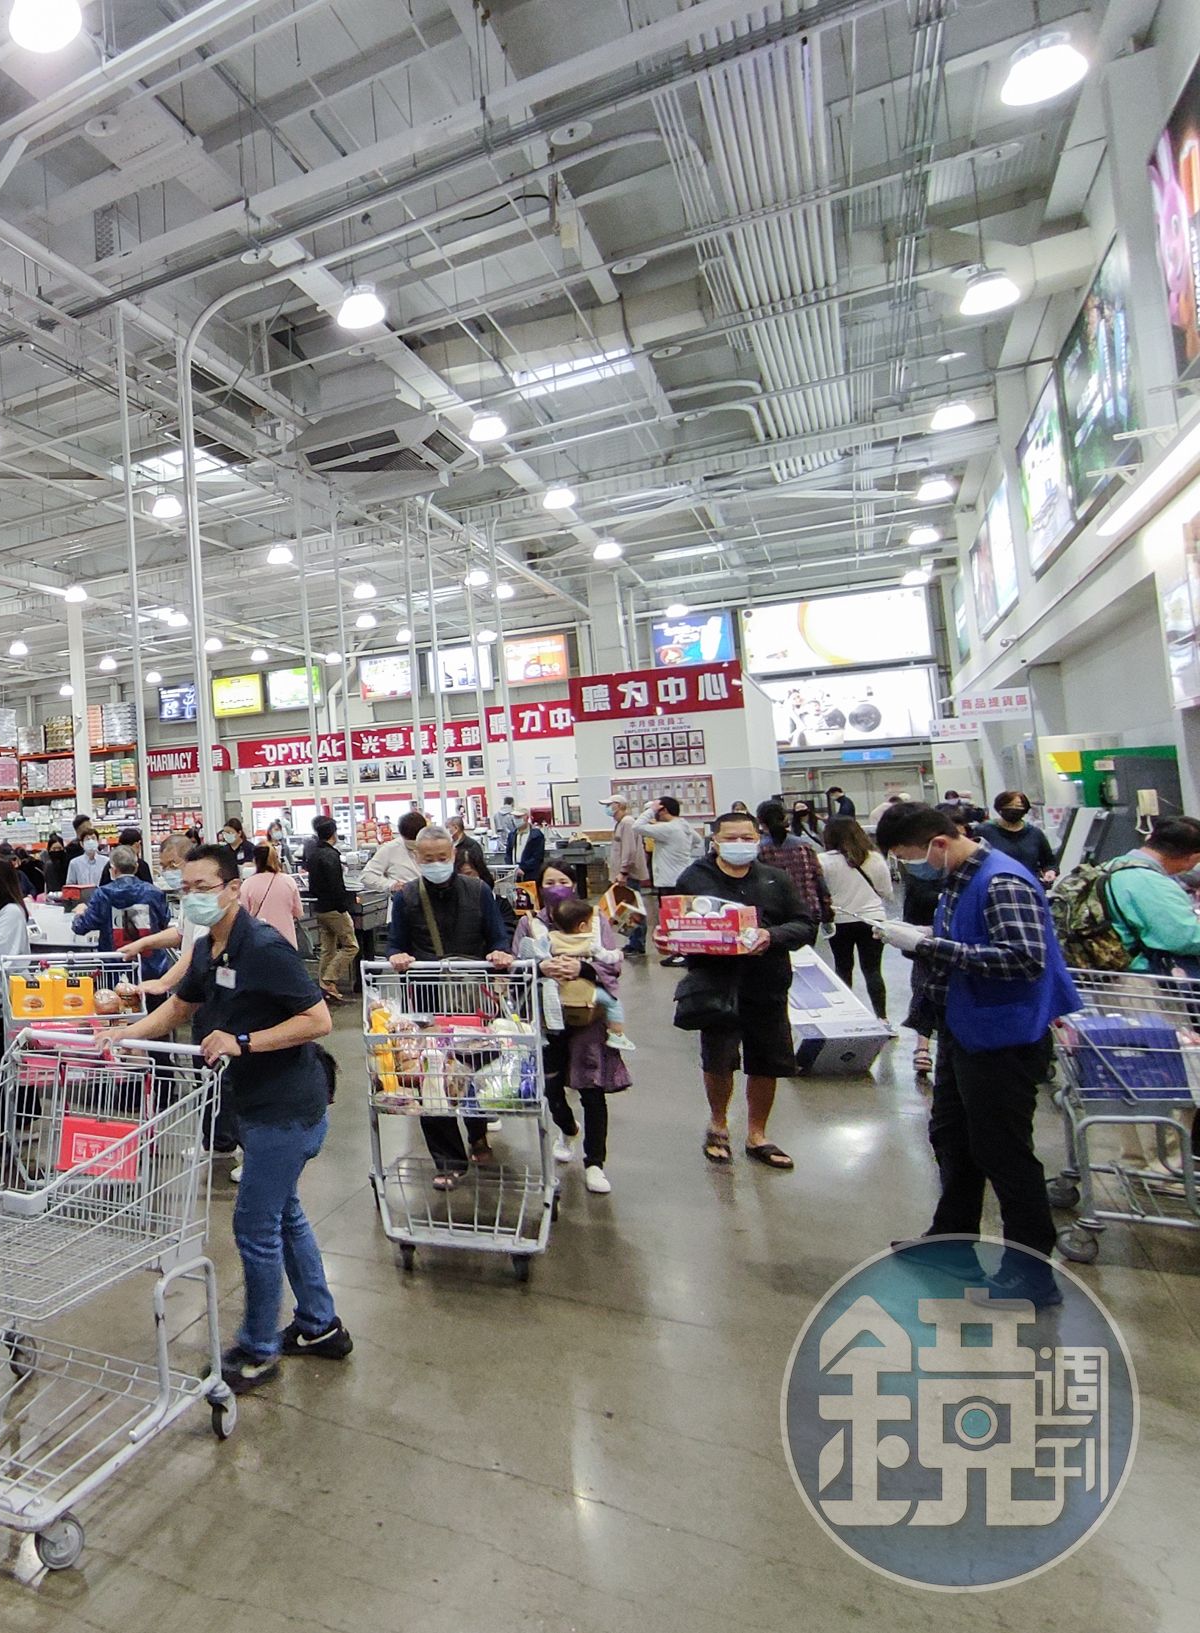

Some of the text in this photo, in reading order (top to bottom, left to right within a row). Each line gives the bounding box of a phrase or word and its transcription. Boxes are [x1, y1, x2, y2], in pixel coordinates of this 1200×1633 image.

[582, 673, 728, 712] 聽力中心
[146, 752, 192, 772] PHARMACY
[264, 738, 342, 762] OPTICAL
